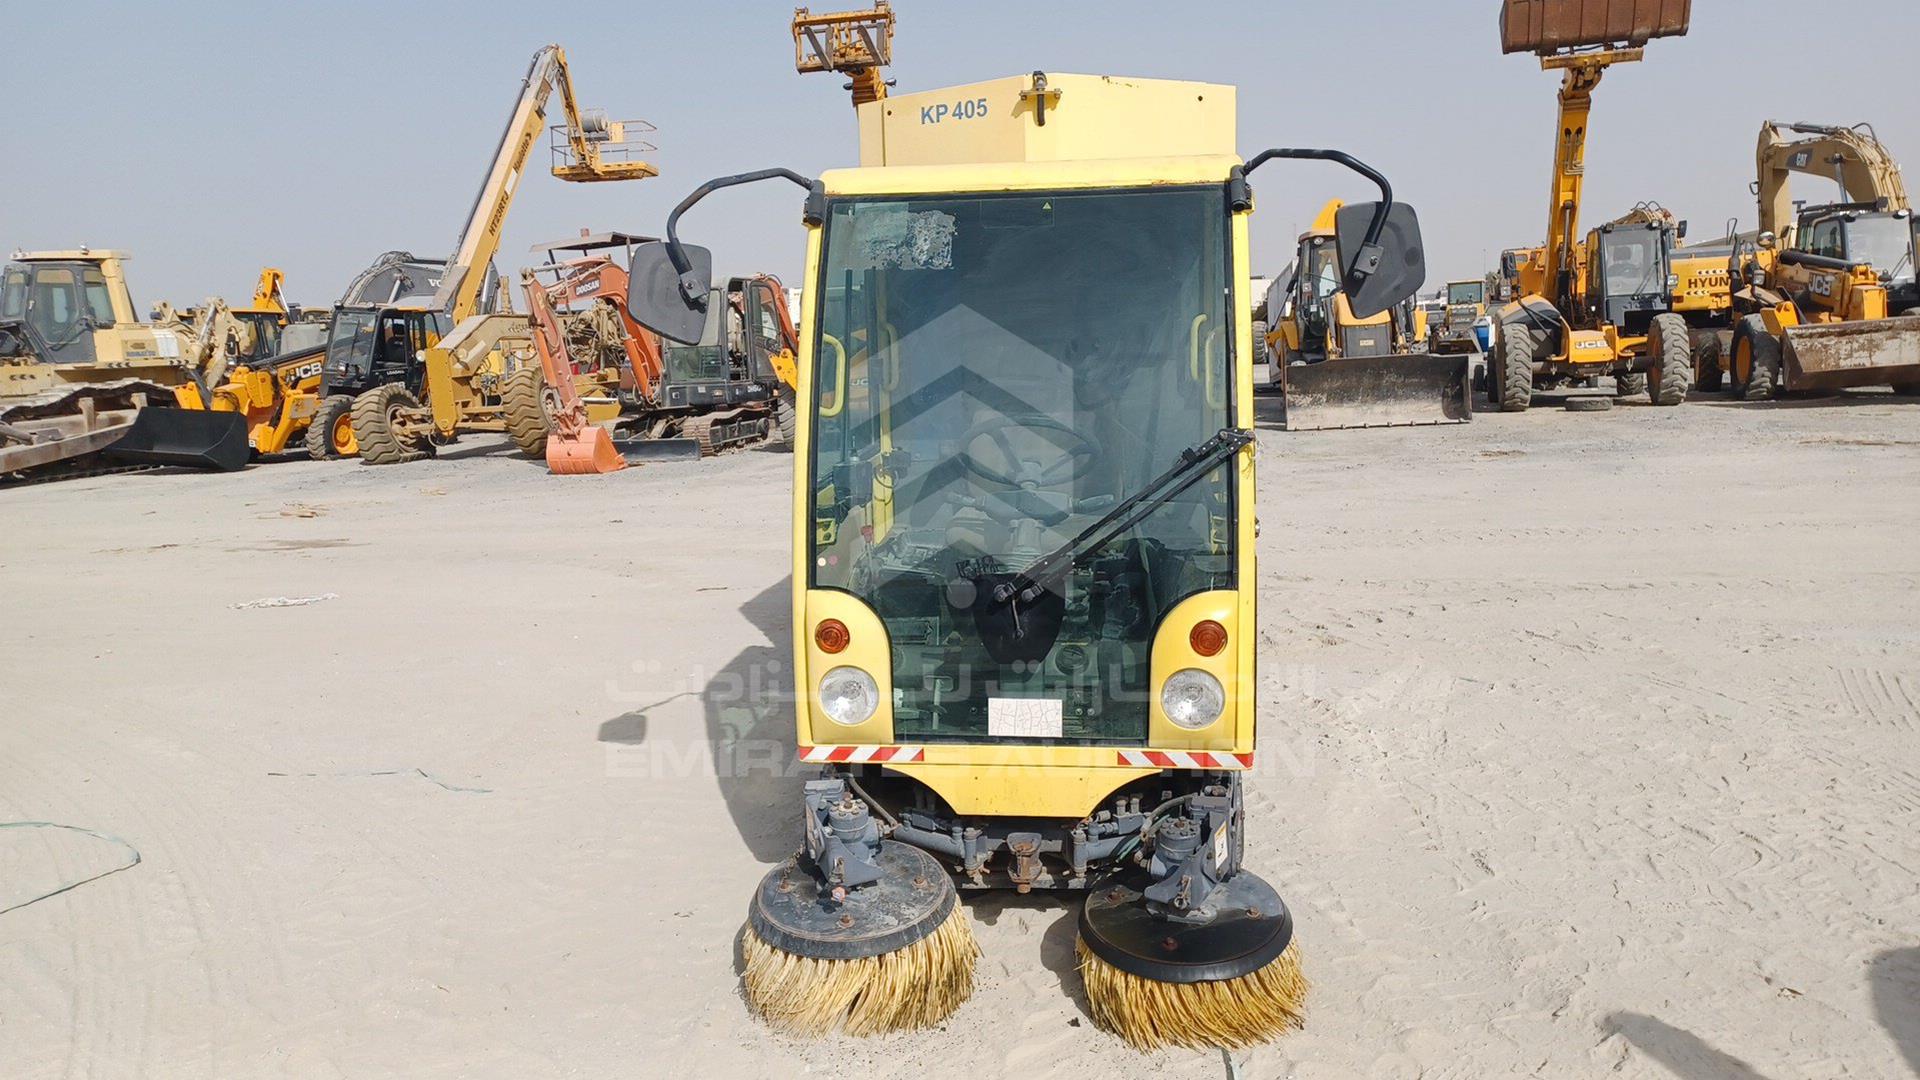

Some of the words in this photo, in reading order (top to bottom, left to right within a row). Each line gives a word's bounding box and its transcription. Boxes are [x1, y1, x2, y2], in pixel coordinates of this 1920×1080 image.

[921, 104, 948, 125] KP
[952, 98, 988, 120] 405
[1796, 152, 1808, 167] CAT
[1808, 274, 1832, 296] JCB
[286, 361, 322, 381] JCB
